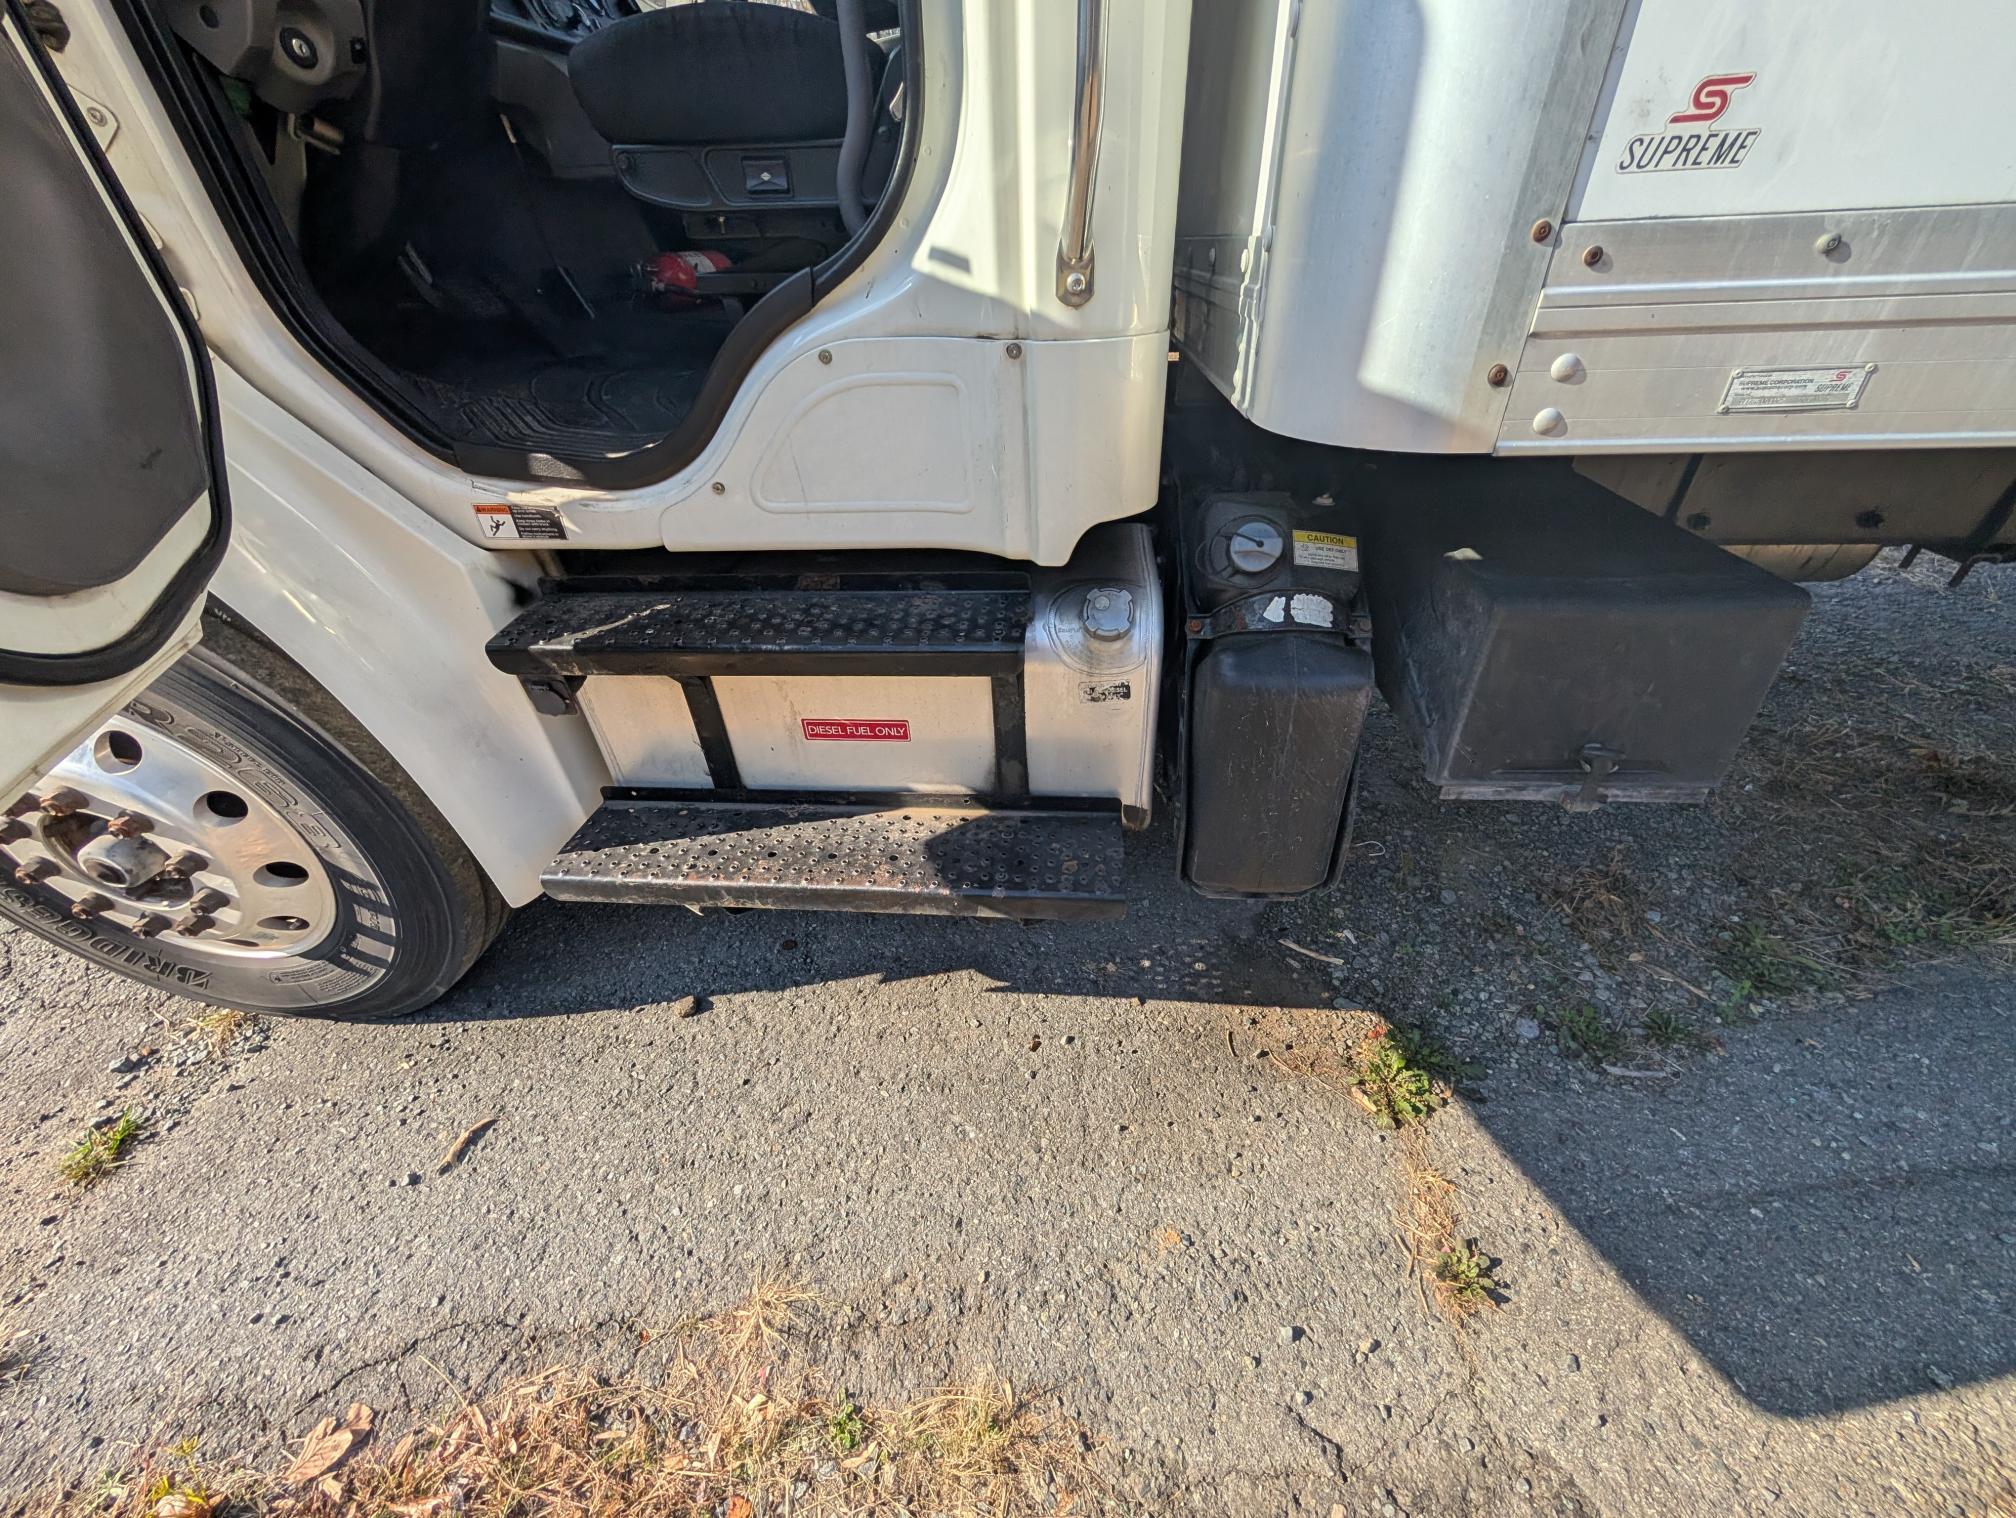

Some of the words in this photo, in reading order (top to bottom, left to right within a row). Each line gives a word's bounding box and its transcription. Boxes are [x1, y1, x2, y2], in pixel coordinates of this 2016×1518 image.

[1619, 131, 1757, 170] SUPREME
[1814, 382, 1853, 393] SUPREME
[1307, 534, 1344, 545] CAUTION
[808, 725, 845, 735] DIESEL
[847, 726, 874, 736] FUEL
[876, 727, 905, 736] ONLY
